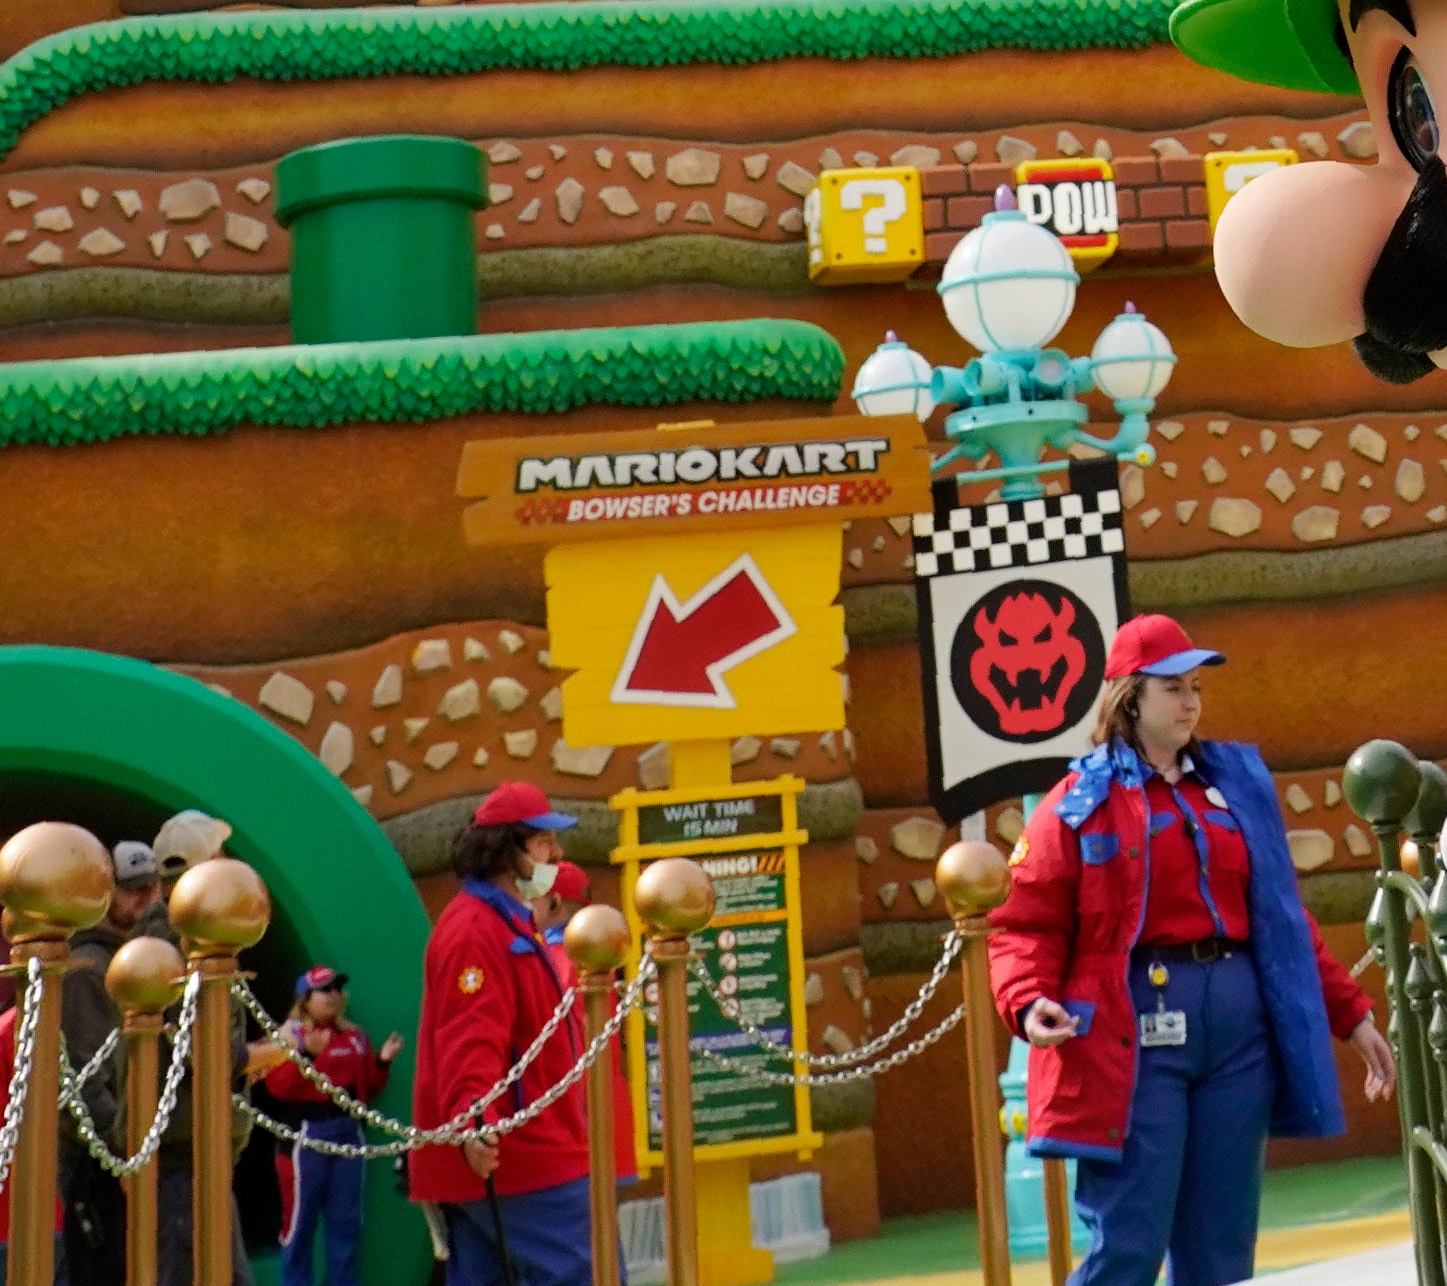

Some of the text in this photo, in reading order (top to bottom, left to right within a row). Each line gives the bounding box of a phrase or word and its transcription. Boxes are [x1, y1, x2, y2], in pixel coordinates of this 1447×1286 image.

[1017, 180, 1118, 235] POW
[567, 484, 841, 522] BOWSER'S CHALLENGE
[663, 798, 755, 822] WAIT TIME
[702, 855, 758, 878] NING!
